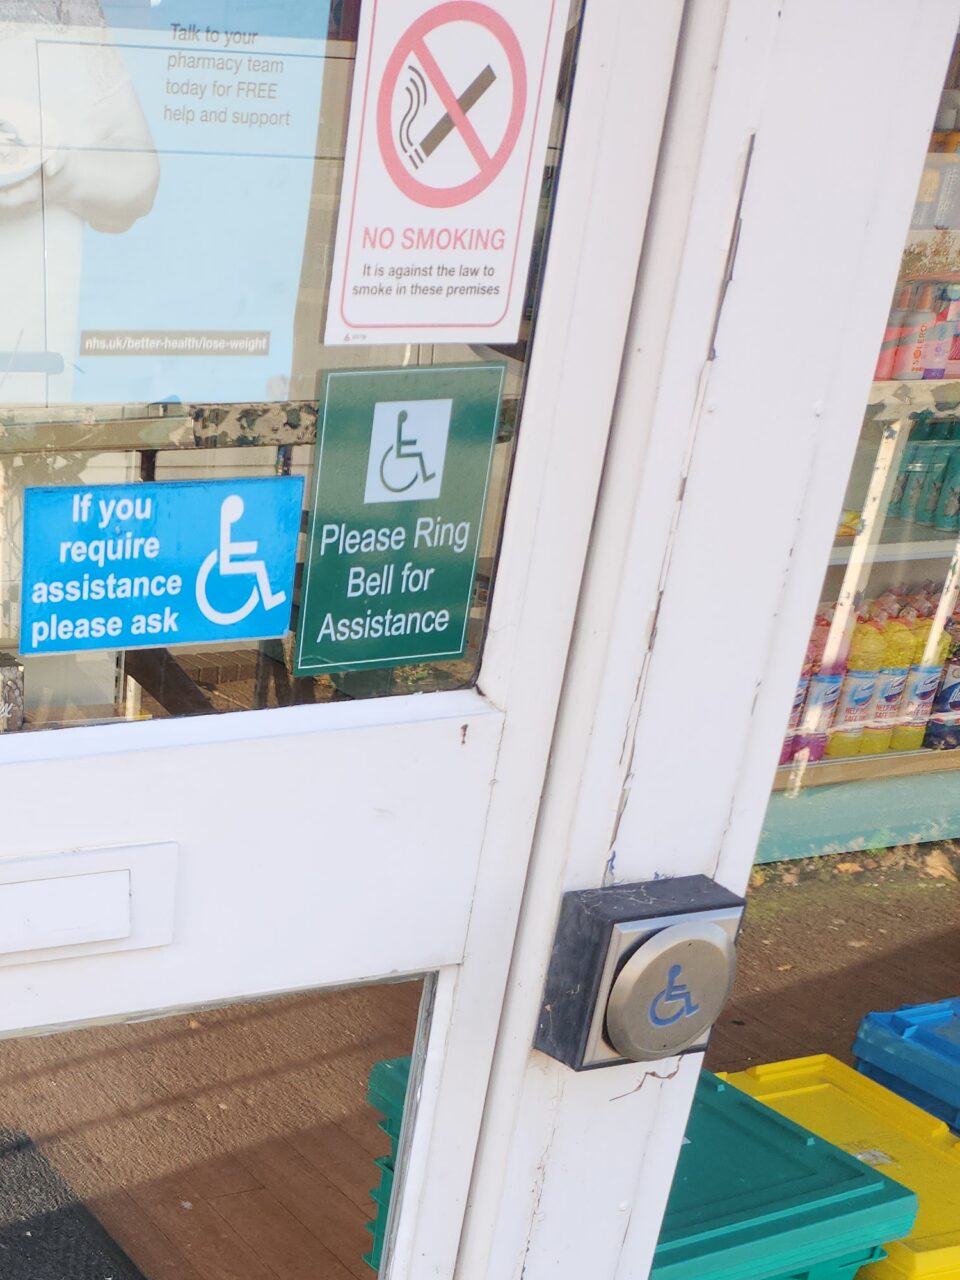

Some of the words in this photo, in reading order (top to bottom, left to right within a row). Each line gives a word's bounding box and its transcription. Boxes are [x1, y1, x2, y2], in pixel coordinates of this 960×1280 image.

[170, 22, 201, 41] Talk
[205, 26, 220, 43] to
[223, 30, 259, 48] your
[167, 51, 243, 75] pharmacy
[247, 56, 285, 74] team
[165, 77, 208, 100] today
[211, 80, 233, 97] for
[236, 81, 279, 99] FREE
[163, 104, 196, 126] help
[200, 107, 228, 124] and
[231, 111, 292, 128] support
[361, 226, 396, 250] NO
[401, 227, 507, 251] SMOKING
[362, 263, 372, 277] It
[374, 264, 385, 277] is
[388, 263, 434, 280] against
[436, 263, 456, 278] the
[458, 264, 480, 277] law
[483, 265, 495, 277] to
[351, 283, 393, 296] smoke
[395, 283, 407, 296] in
[410, 283, 444, 296] these
[446, 282, 501, 298] premises
[84, 335, 268, 352] nhs.uk/better-health/lose-weight
[71, 493, 94, 523] If
[98, 497, 153, 529] you
[319, 522, 407, 557] Please
[413, 515, 471, 554] Ring
[58, 531, 161, 568] require
[30, 572, 183, 604] assistance
[346, 563, 395, 599] Bell
[400, 561, 437, 594] for
[30, 613, 124, 649] please
[130, 606, 180, 635] ask
[315, 607, 450, 644] Assistance
